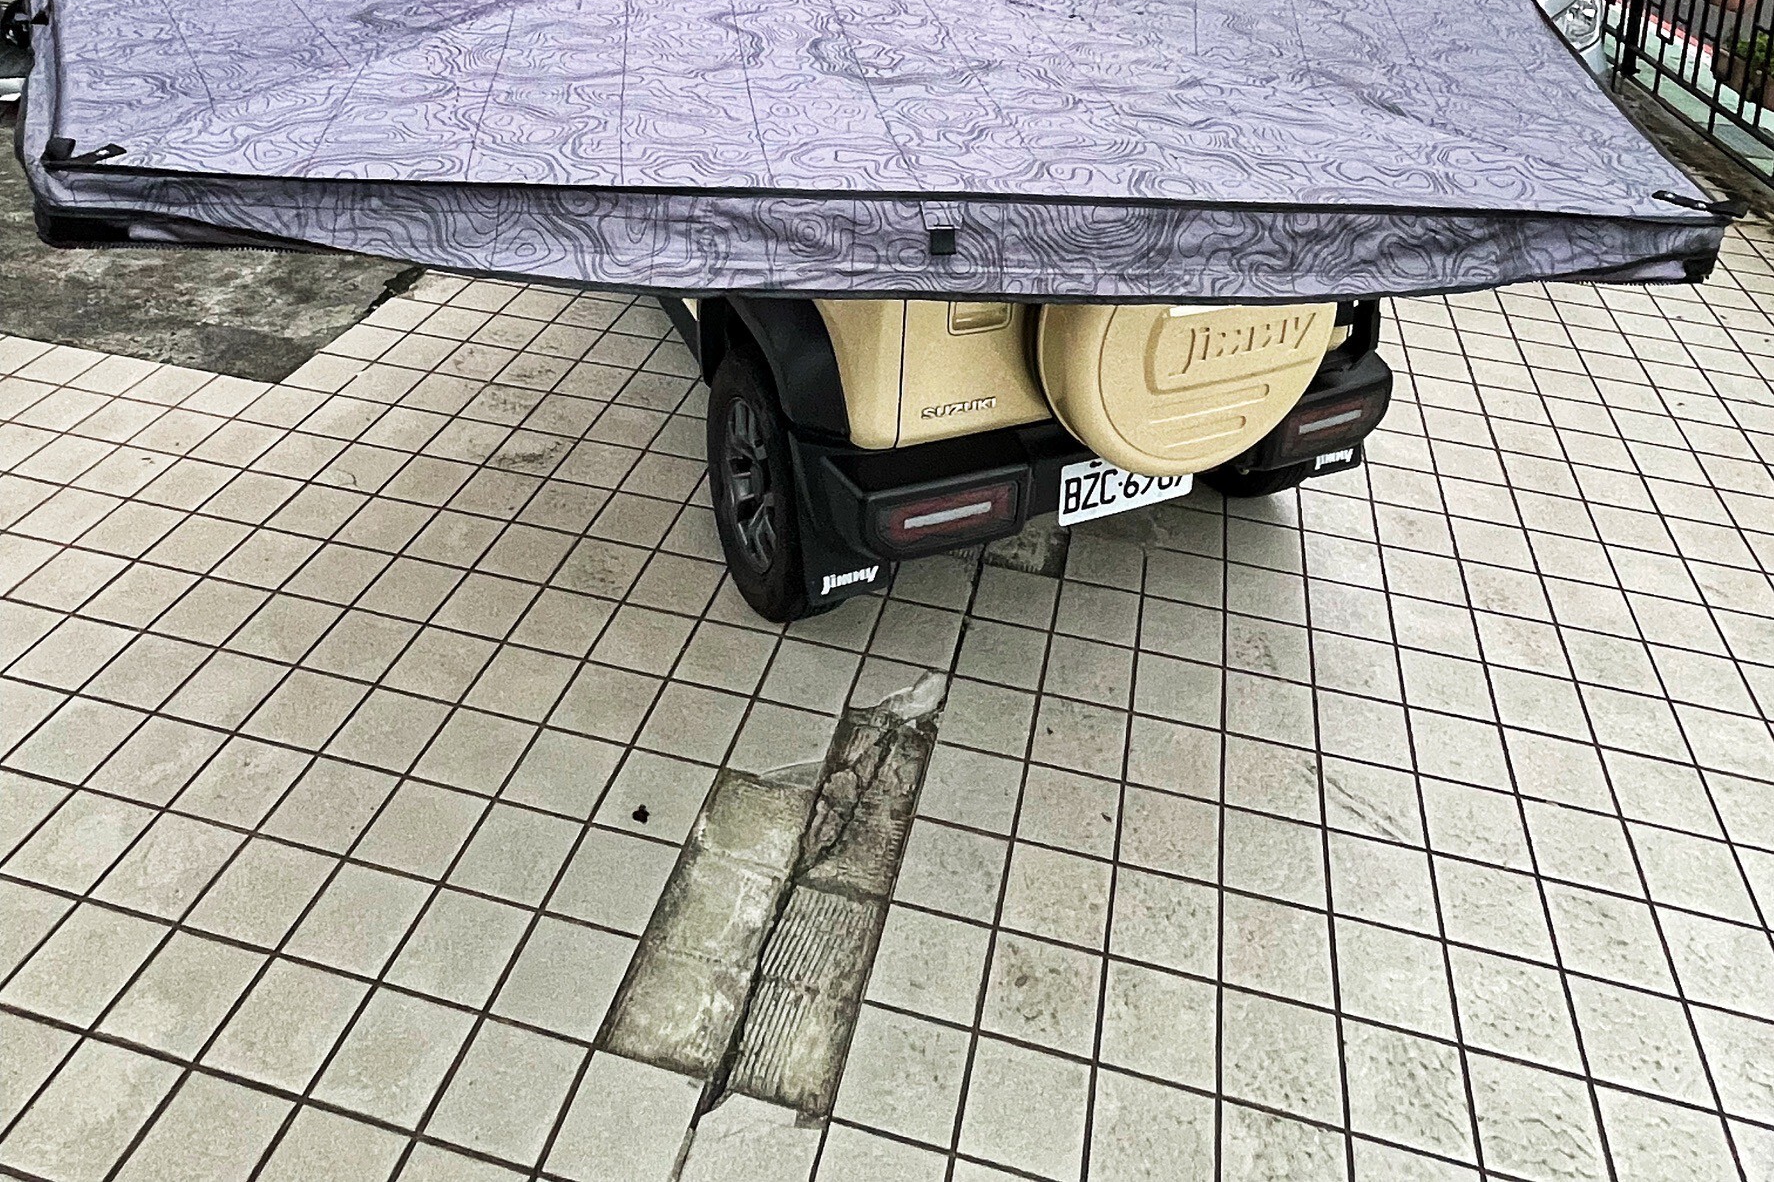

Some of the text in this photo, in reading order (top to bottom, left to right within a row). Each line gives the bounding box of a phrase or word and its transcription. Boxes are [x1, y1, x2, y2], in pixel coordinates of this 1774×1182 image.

[1168, 312, 1316, 378] Jimny
[920, 396, 997, 419] SUZUKI
[1314, 448, 1354, 471] Jimny
[821, 565, 879, 596] Jimny
